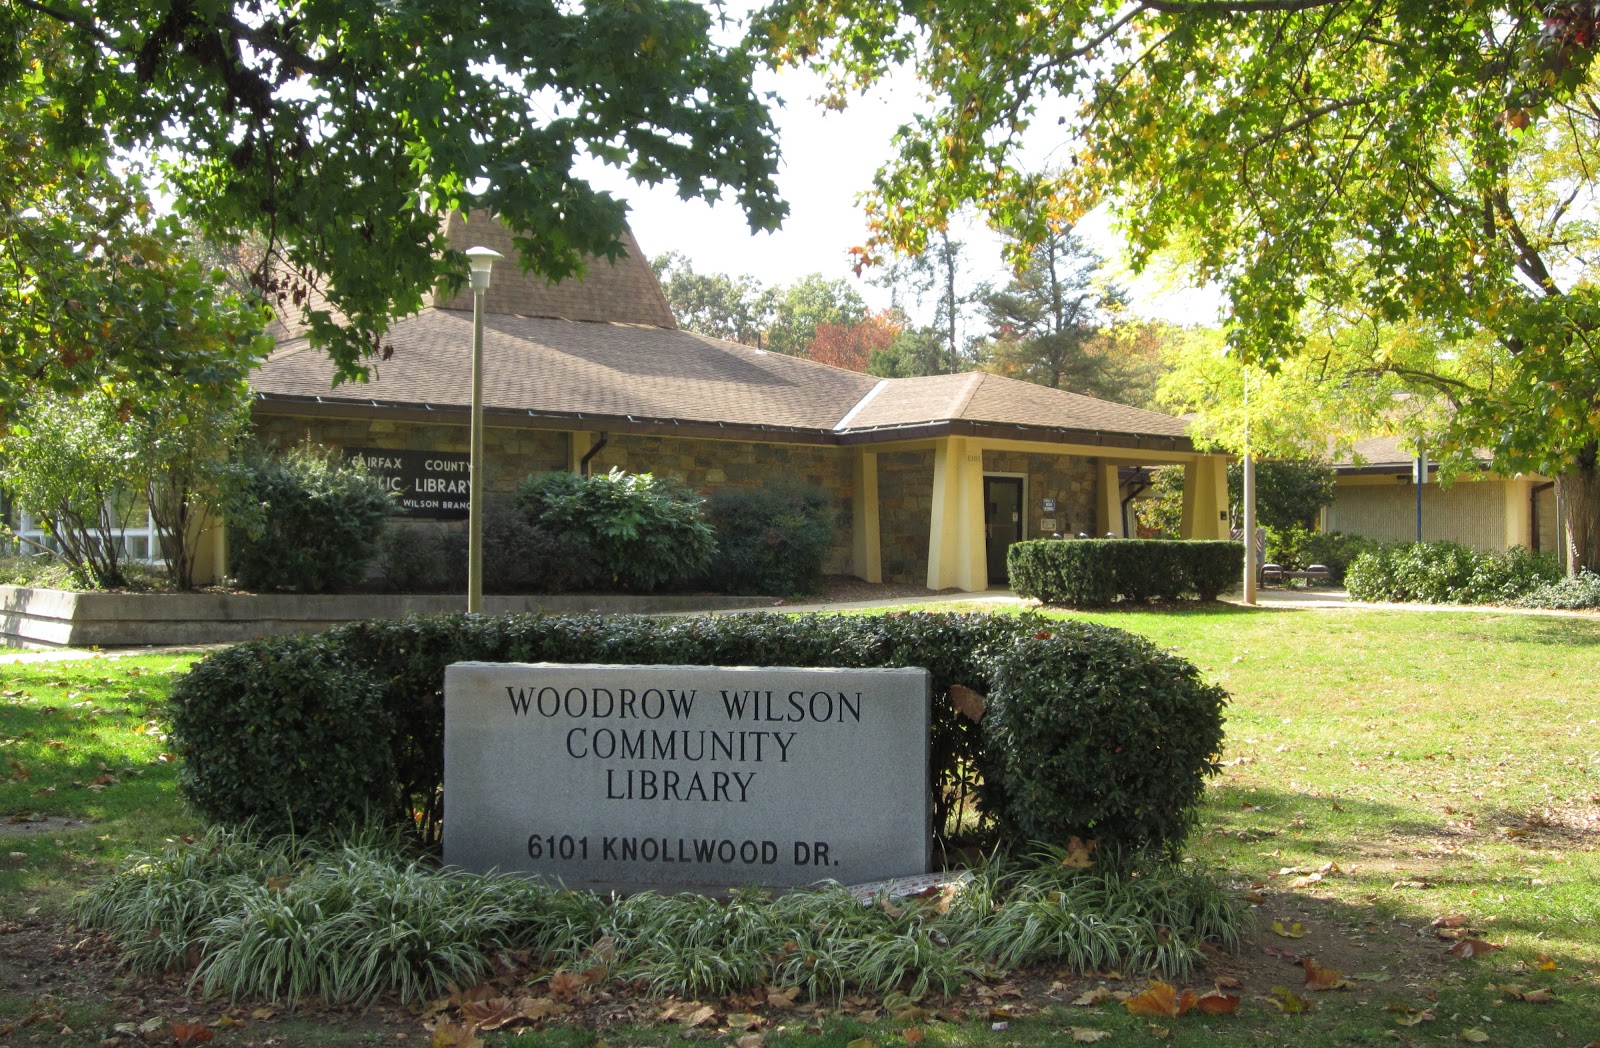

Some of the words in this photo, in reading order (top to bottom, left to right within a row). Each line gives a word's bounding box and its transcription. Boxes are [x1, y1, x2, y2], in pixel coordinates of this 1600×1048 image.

[352, 455, 402, 469] FAIRFAX
[425, 460, 471, 472] COUNTY
[403, 499, 439, 508] WILSON
[442, 501, 470, 510] BRANC
[505, 686, 697, 720] WOODROW
[719, 690, 863, 723] WILSON
[566, 727, 798, 763] COMMUNITY
[606, 769, 757, 803] LIBRARY
[527, 834, 588, 860] 6101
[602, 837, 778, 865] KNOLLWOOD
[794, 841, 840, 867] DR.
